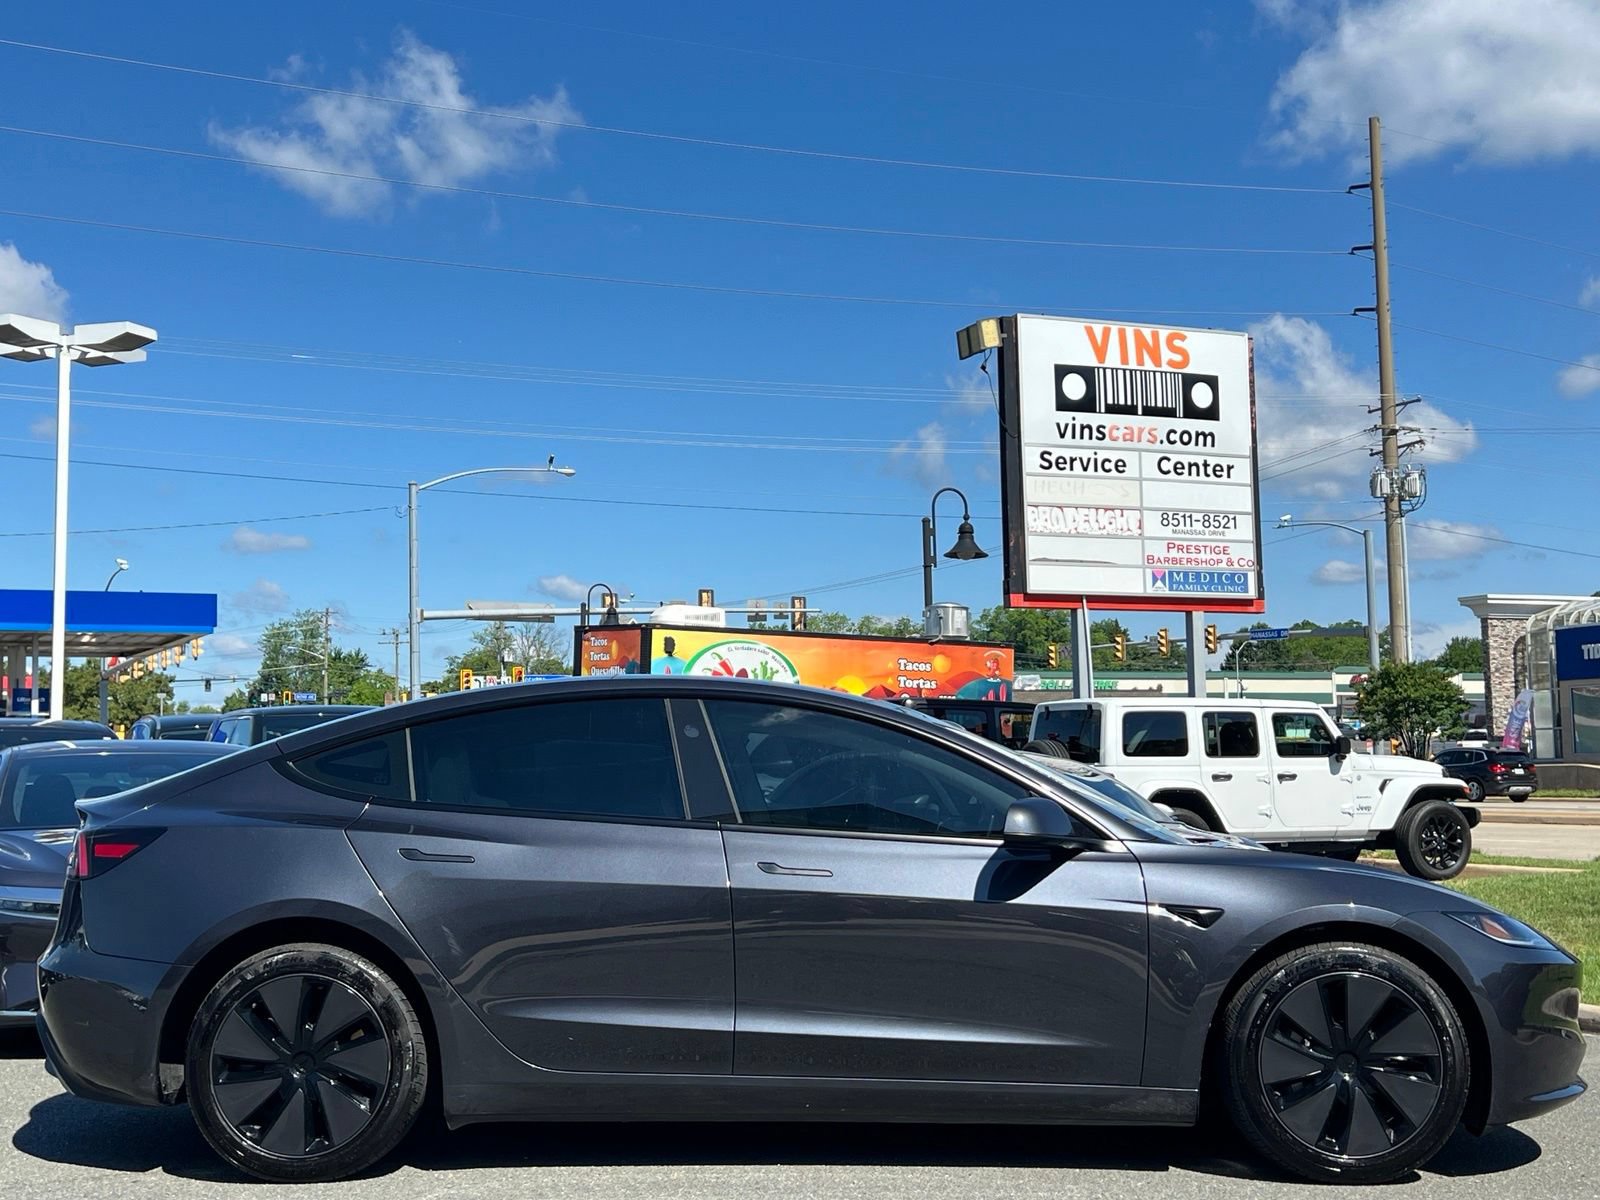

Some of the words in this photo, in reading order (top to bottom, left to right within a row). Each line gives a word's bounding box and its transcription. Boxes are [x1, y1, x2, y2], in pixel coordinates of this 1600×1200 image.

[1084, 325, 1192, 370] VINS
[1055, 416, 1216, 448] vinscars.com
[1039, 450, 1127, 474] Service
[1156, 456, 1235, 479] Center
[1160, 512, 1237, 530] 8511-8521
[1171, 528, 1206, 536] MANASSAS
[1207, 529, 1226, 537] DRIVE
[1225, 557, 1235, 567] &
[1172, 571, 1245, 584] MEDICO
[1172, 584, 1211, 592] FAMILY
[1250, 630, 1278, 639] MANASSAS
[590, 636, 608, 647] Tacos
[590, 651, 610, 661] Tortas
[897, 658, 932, 672] Tacos
[897, 675, 937, 690] Tortas
[1040, 680, 1073, 690] DOLL
